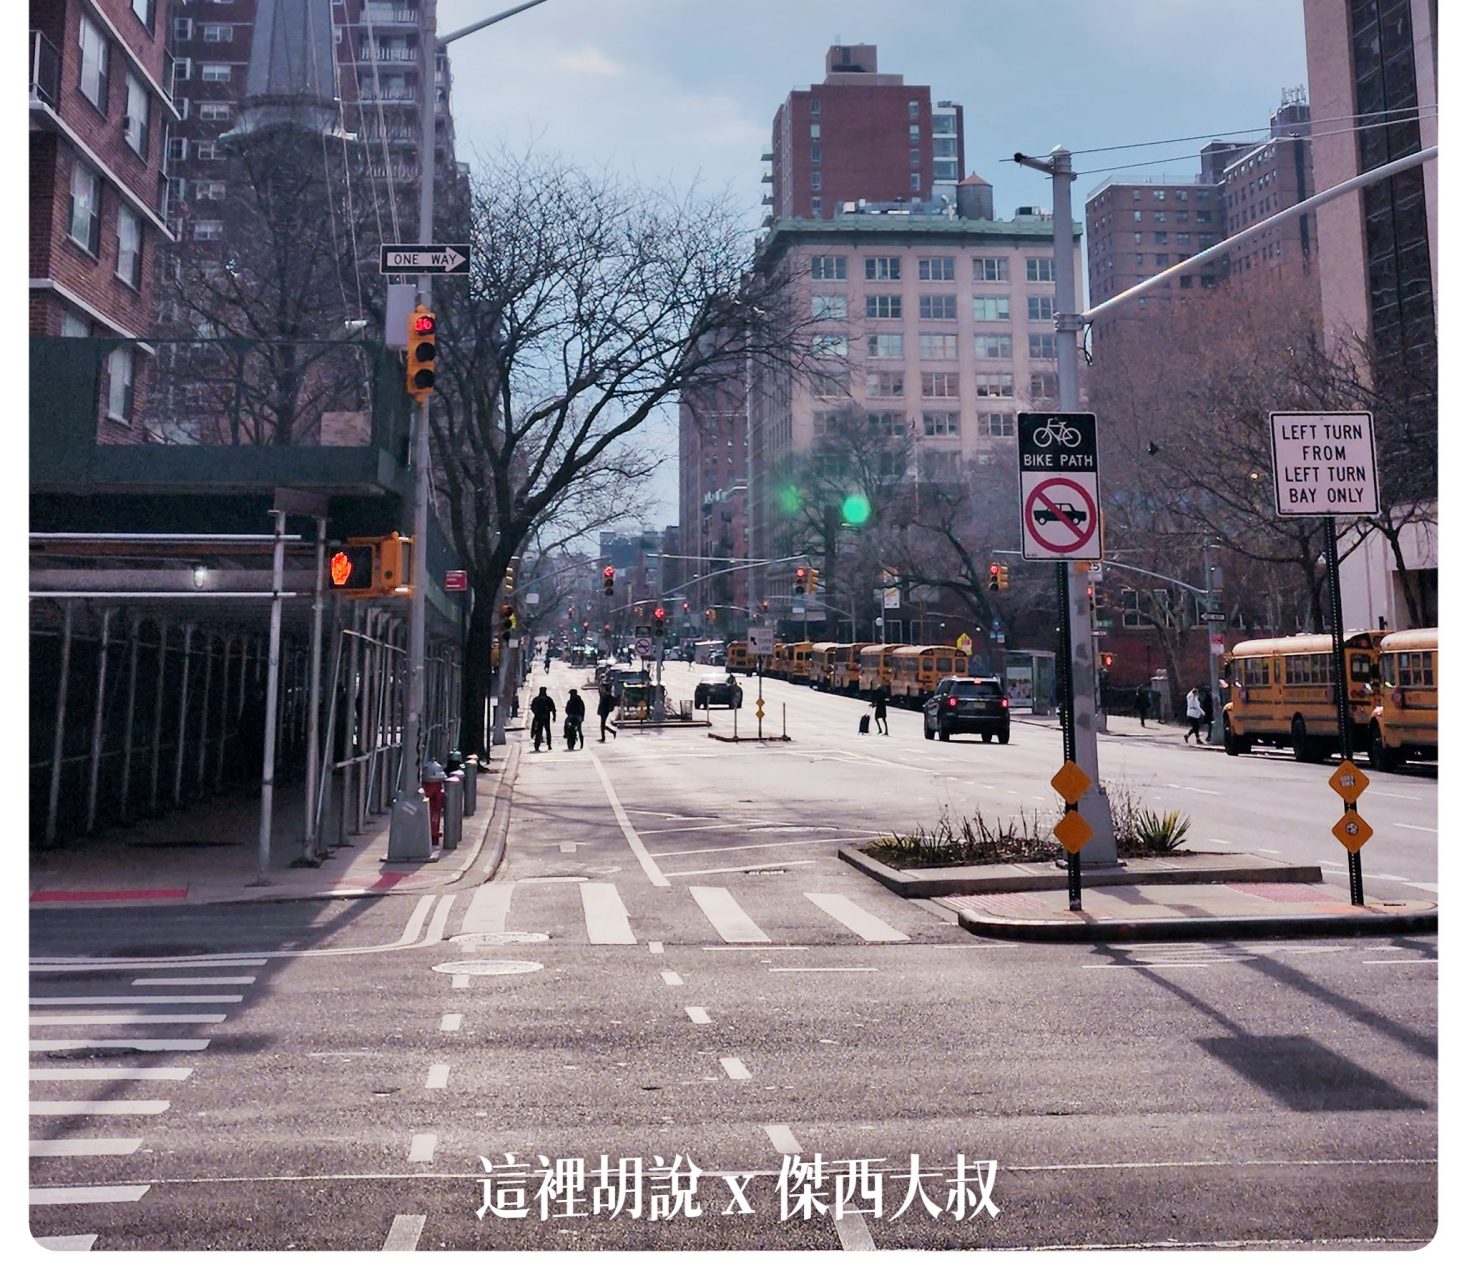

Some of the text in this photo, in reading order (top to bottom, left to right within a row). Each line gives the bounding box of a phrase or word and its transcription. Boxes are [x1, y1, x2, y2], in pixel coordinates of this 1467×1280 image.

[394, 253, 457, 265] ONE WAY
[1282, 424, 1363, 440] LEFT TURN
[1023, 454, 1094, 467] BIKE PATH
[1302, 445, 1346, 461] FROM
[1285, 466, 1366, 482] LEFT TURN
[1289, 487, 1364, 503] BAY ONLY
